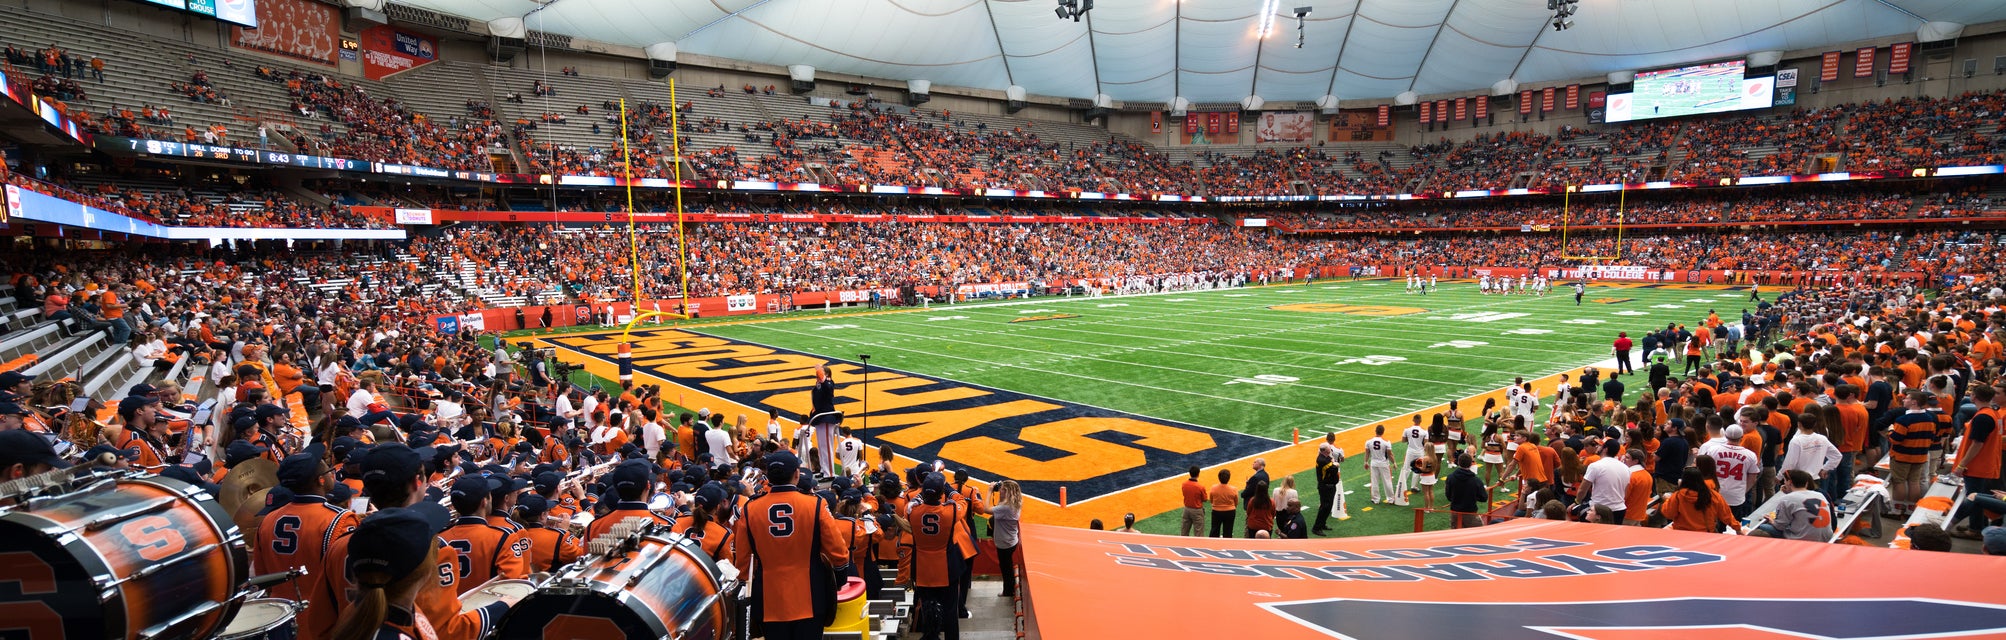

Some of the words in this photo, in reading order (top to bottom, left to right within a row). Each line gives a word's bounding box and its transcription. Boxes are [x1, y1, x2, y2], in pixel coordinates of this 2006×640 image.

[188, 2, 214, 14] CROUSE
[396, 33, 417, 46] United
[405, 43, 417, 56] Way
[130, 140, 137, 150] 7
[162, 141, 177, 149] TOL
[190, 144, 207, 152] BALL
[210, 145, 231, 154] DOWN
[214, 152, 229, 160] 3RD
[269, 153, 289, 163] 6:43
[347, 161, 353, 169] 0
[1603, 271, 1644, 279] COLLEGE
[839, 287, 898, 302] 888-DO-TIX
[461, 315, 482, 323] KeyBank
[576, 306, 591, 323] S
[1412, 429, 1420, 439] S
[845, 441, 853, 452] S
[1373, 440, 1381, 450] S
[1717, 451, 1747, 462] HARPER
[1716, 459, 1744, 481] 34
[768, 503, 794, 538] S
[921, 512, 941, 536] S
[120, 515, 187, 562] S
[272, 515, 302, 555] S
[1105, 545, 1727, 582] SYRACUSE
[438, 562, 455, 587] S
